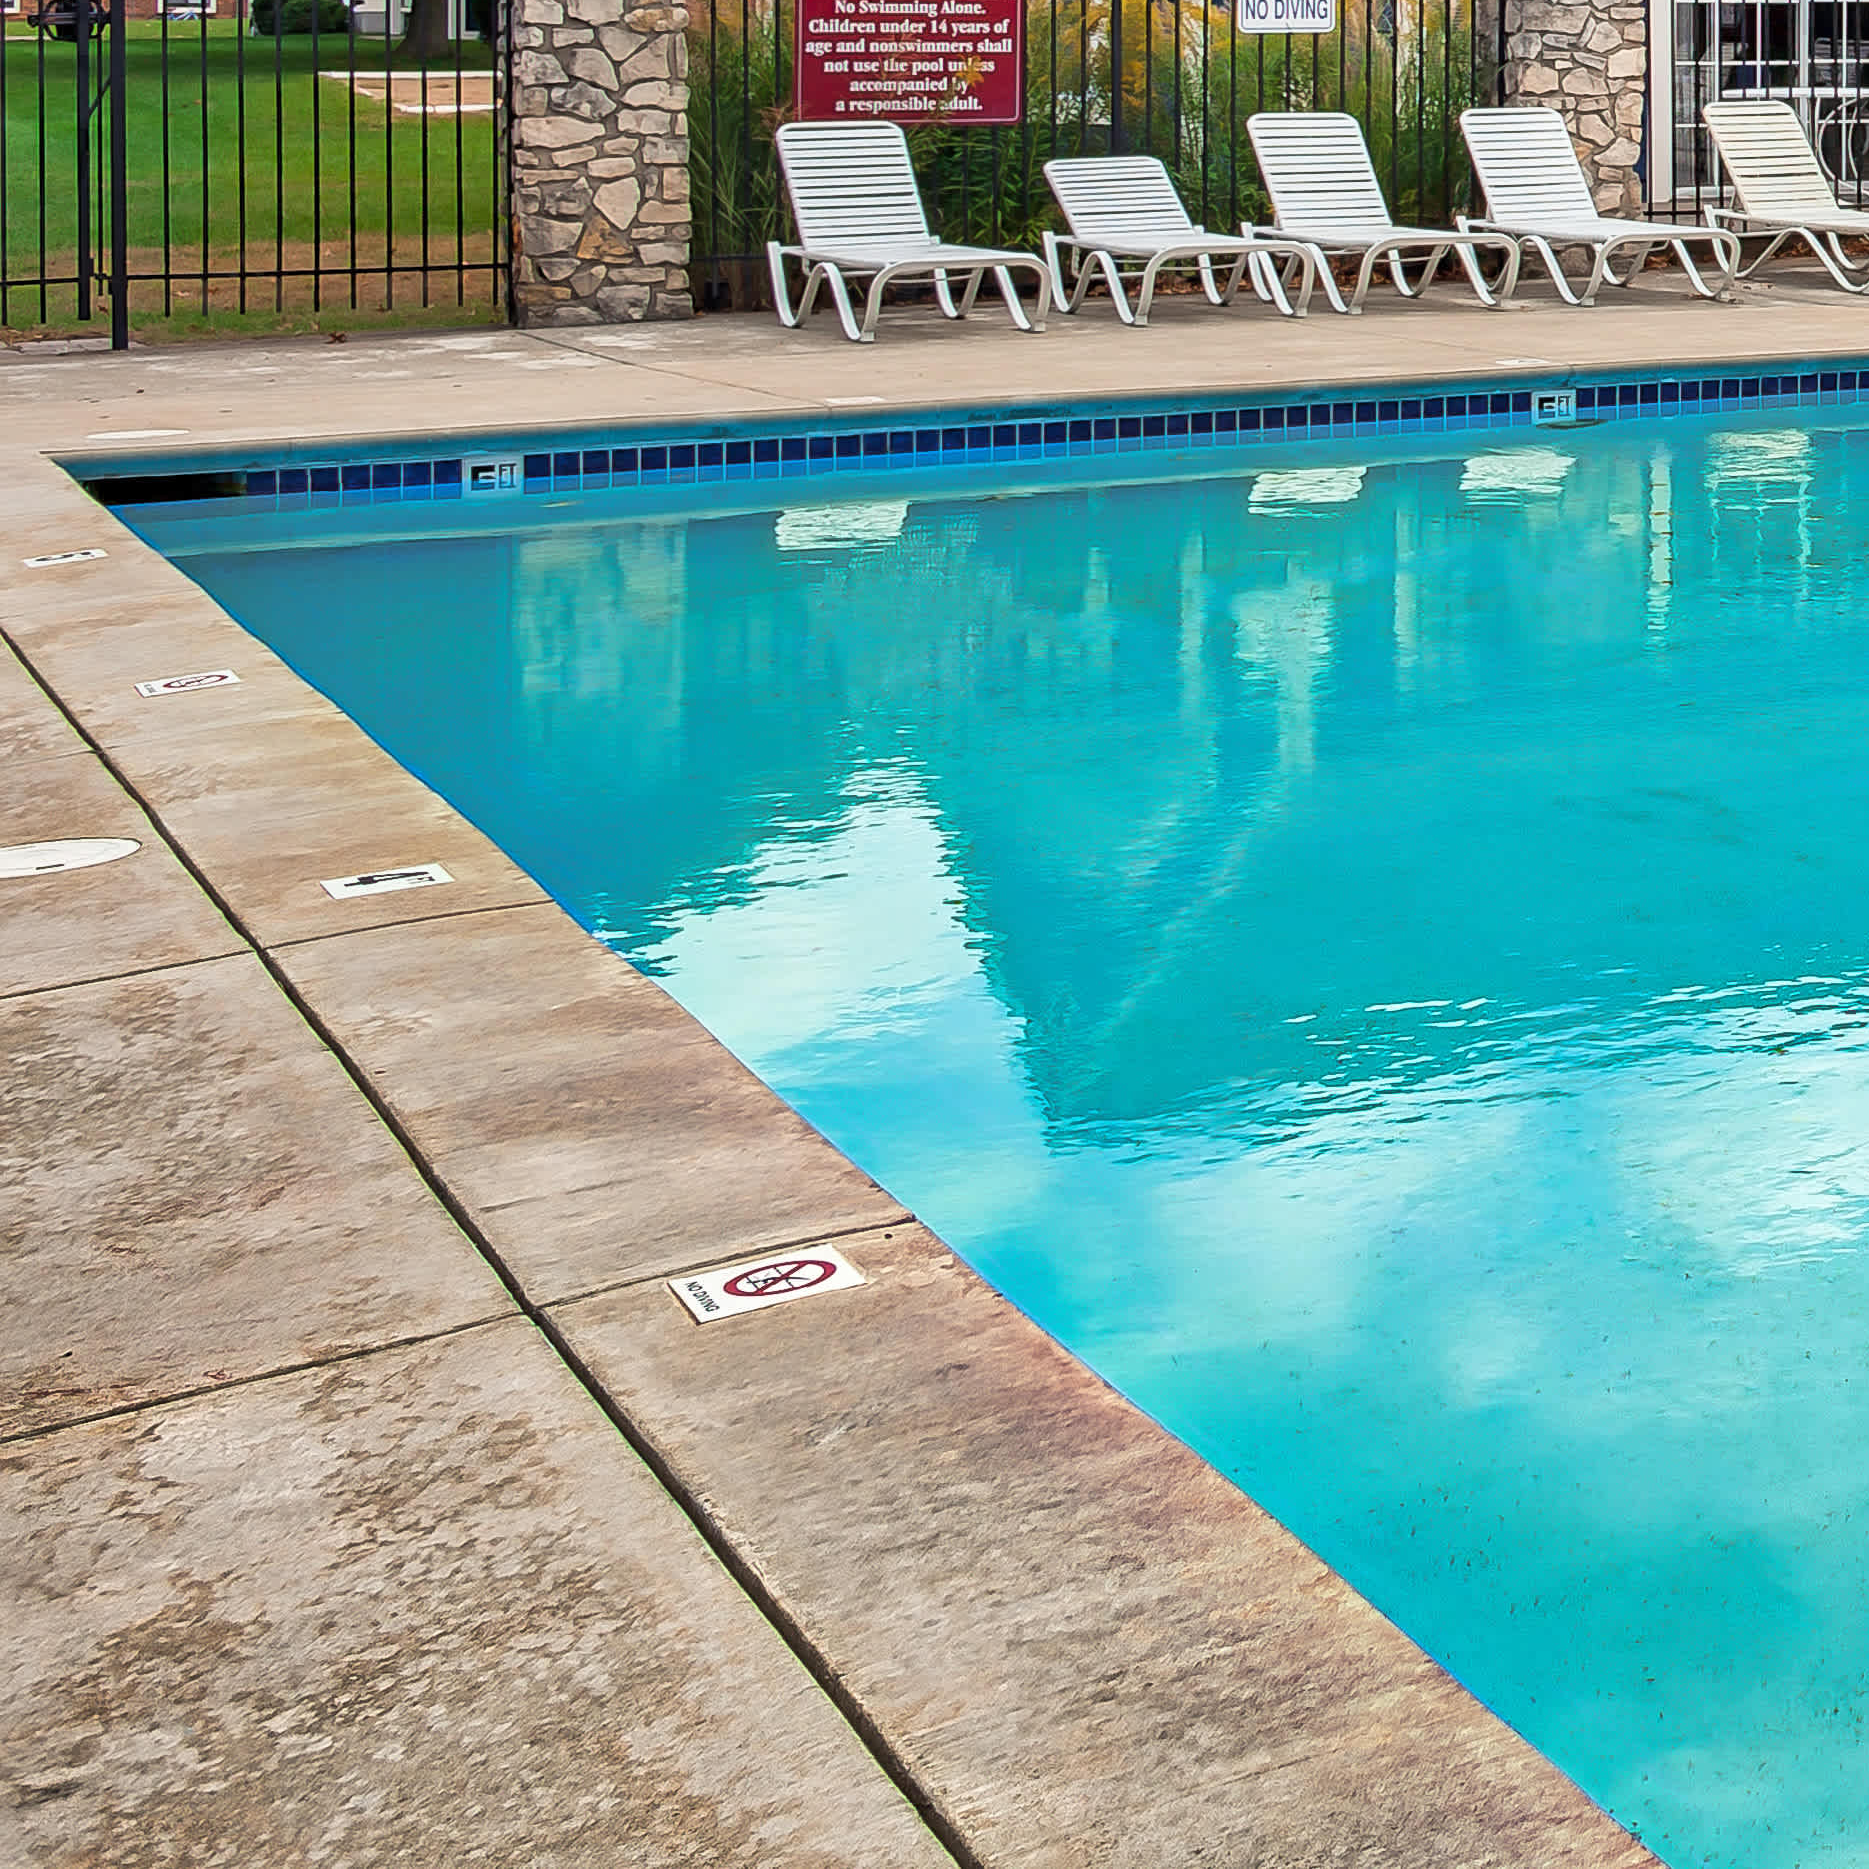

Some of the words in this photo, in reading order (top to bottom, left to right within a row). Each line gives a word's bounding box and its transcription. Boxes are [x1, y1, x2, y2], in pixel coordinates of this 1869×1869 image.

[835, 0, 856, 14] No
[859, 0, 938, 18] Swimming
[941, 0, 987, 15] Alone.
[808, 18, 876, 34] Children
[880, 18, 926, 34] under
[930, 19, 948, 34] 14
[951, 23, 990, 37] years
[993, 18, 1010, 34] of
[805, 41, 832, 56] age
[836, 38, 865, 53] and
[869, 38, 973, 53] nonswimmers
[977, 38, 1013, 53] shall
[823, 59, 849, 73] not
[853, 61, 879, 73] use
[883, 57, 909, 73] the
[912, 57, 944, 75] pool
[849, 77, 948, 95] accompanied
[835, 99, 845, 111] a
[849, 96, 937, 114] responsible
[685, 1281, 703, 1291] NO
[692, 1291, 720, 1312] DIVING
